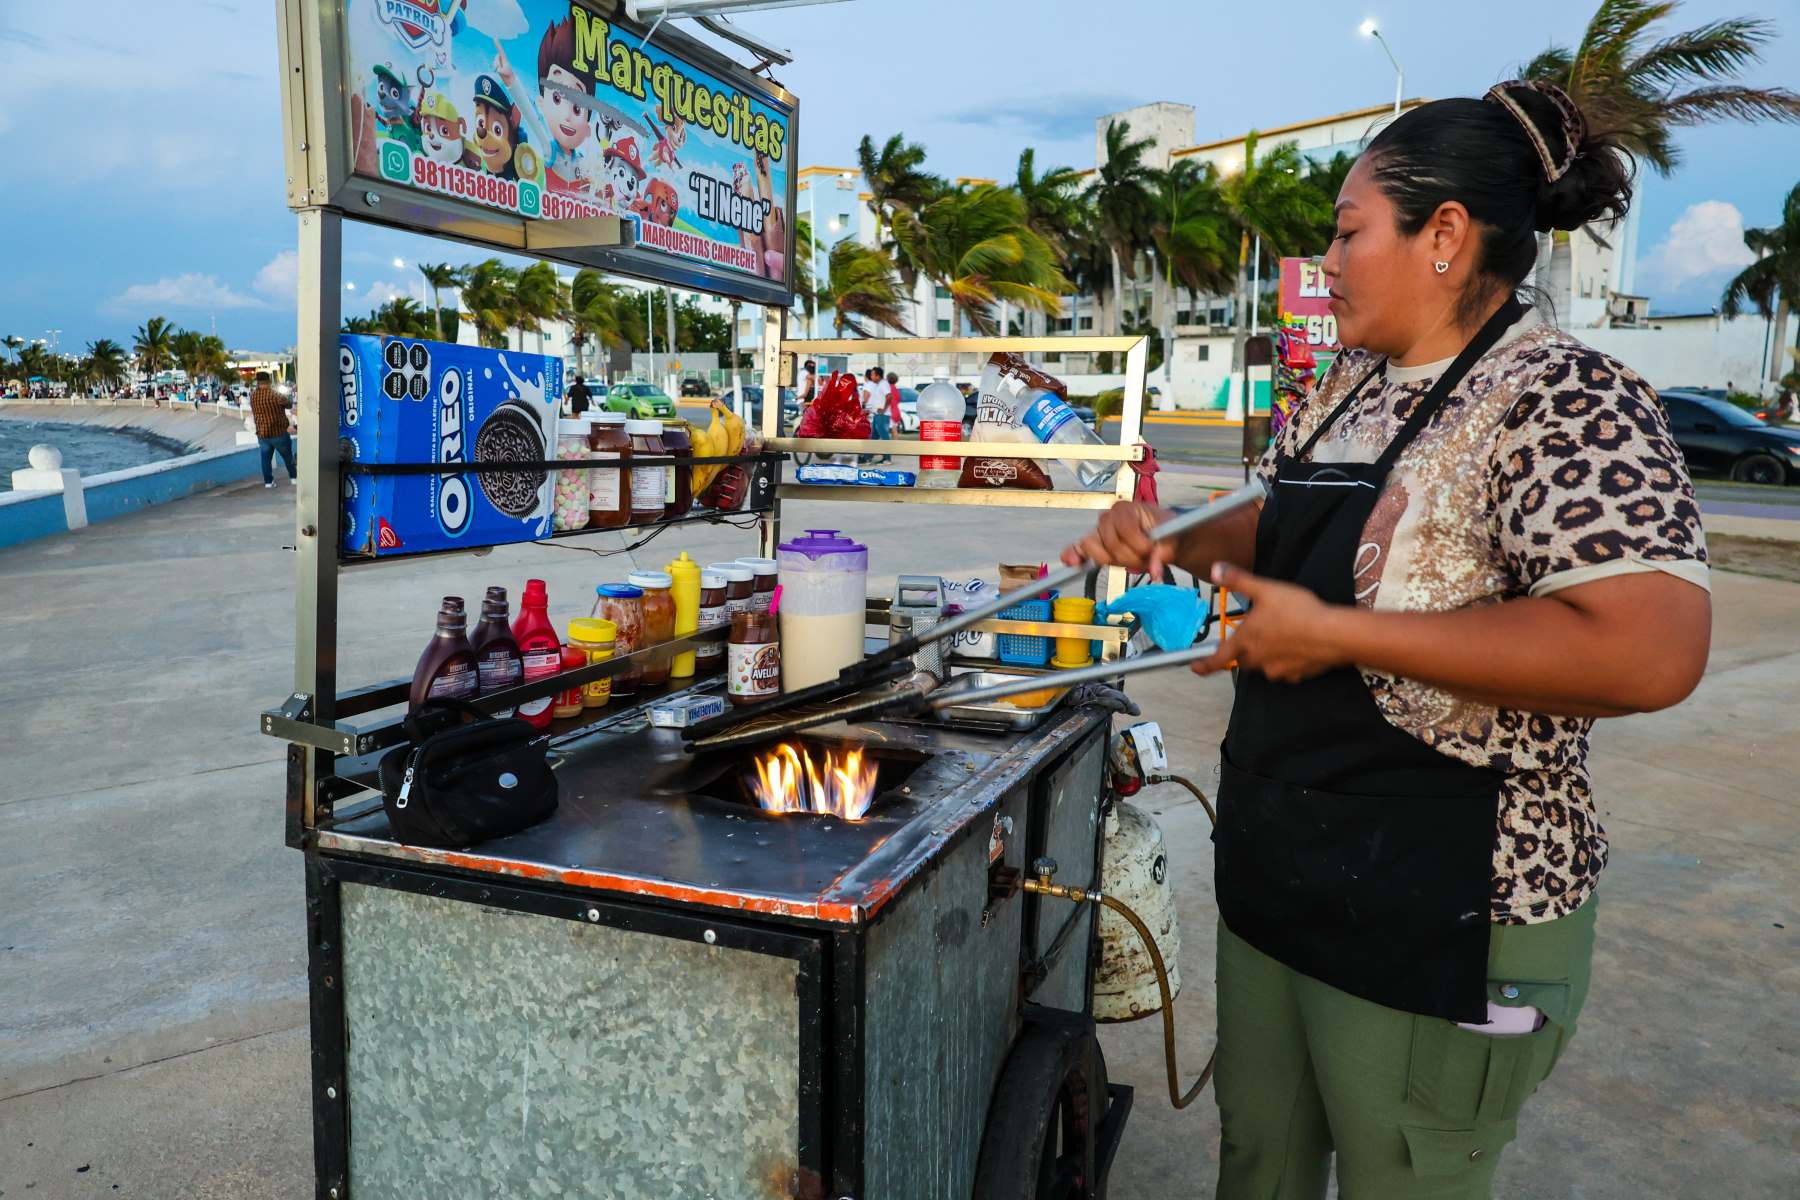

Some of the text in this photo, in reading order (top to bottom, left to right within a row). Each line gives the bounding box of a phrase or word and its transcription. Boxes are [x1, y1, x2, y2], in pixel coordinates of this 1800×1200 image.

[386, 1, 438, 34] PATROL
[571, 5, 785, 161] Marquesitas
[414, 156, 517, 208] 9811358880
[642, 223, 755, 270] MARQUESITAS CAMPECHE
[1299, 263, 1331, 297] EL
[340, 347, 358, 426] OREO
[440, 370, 468, 529] OREO
